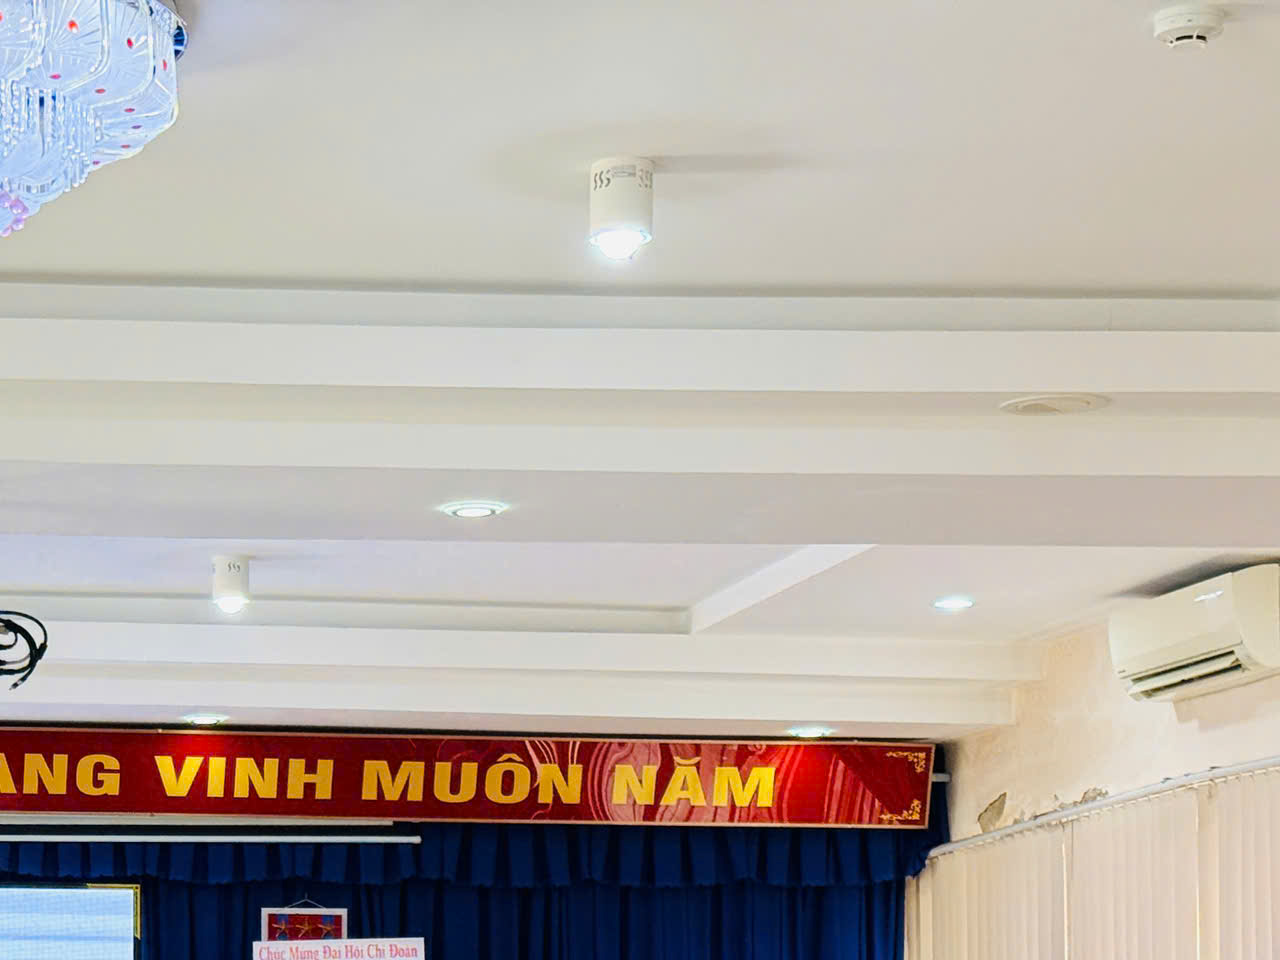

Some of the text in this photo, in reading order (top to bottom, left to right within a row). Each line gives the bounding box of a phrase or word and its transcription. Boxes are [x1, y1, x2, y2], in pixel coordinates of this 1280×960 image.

[154, 755, 333, 801] VINH
[360, 753, 582, 805] MUÔN
[610, 756, 777, 808] NĂM
